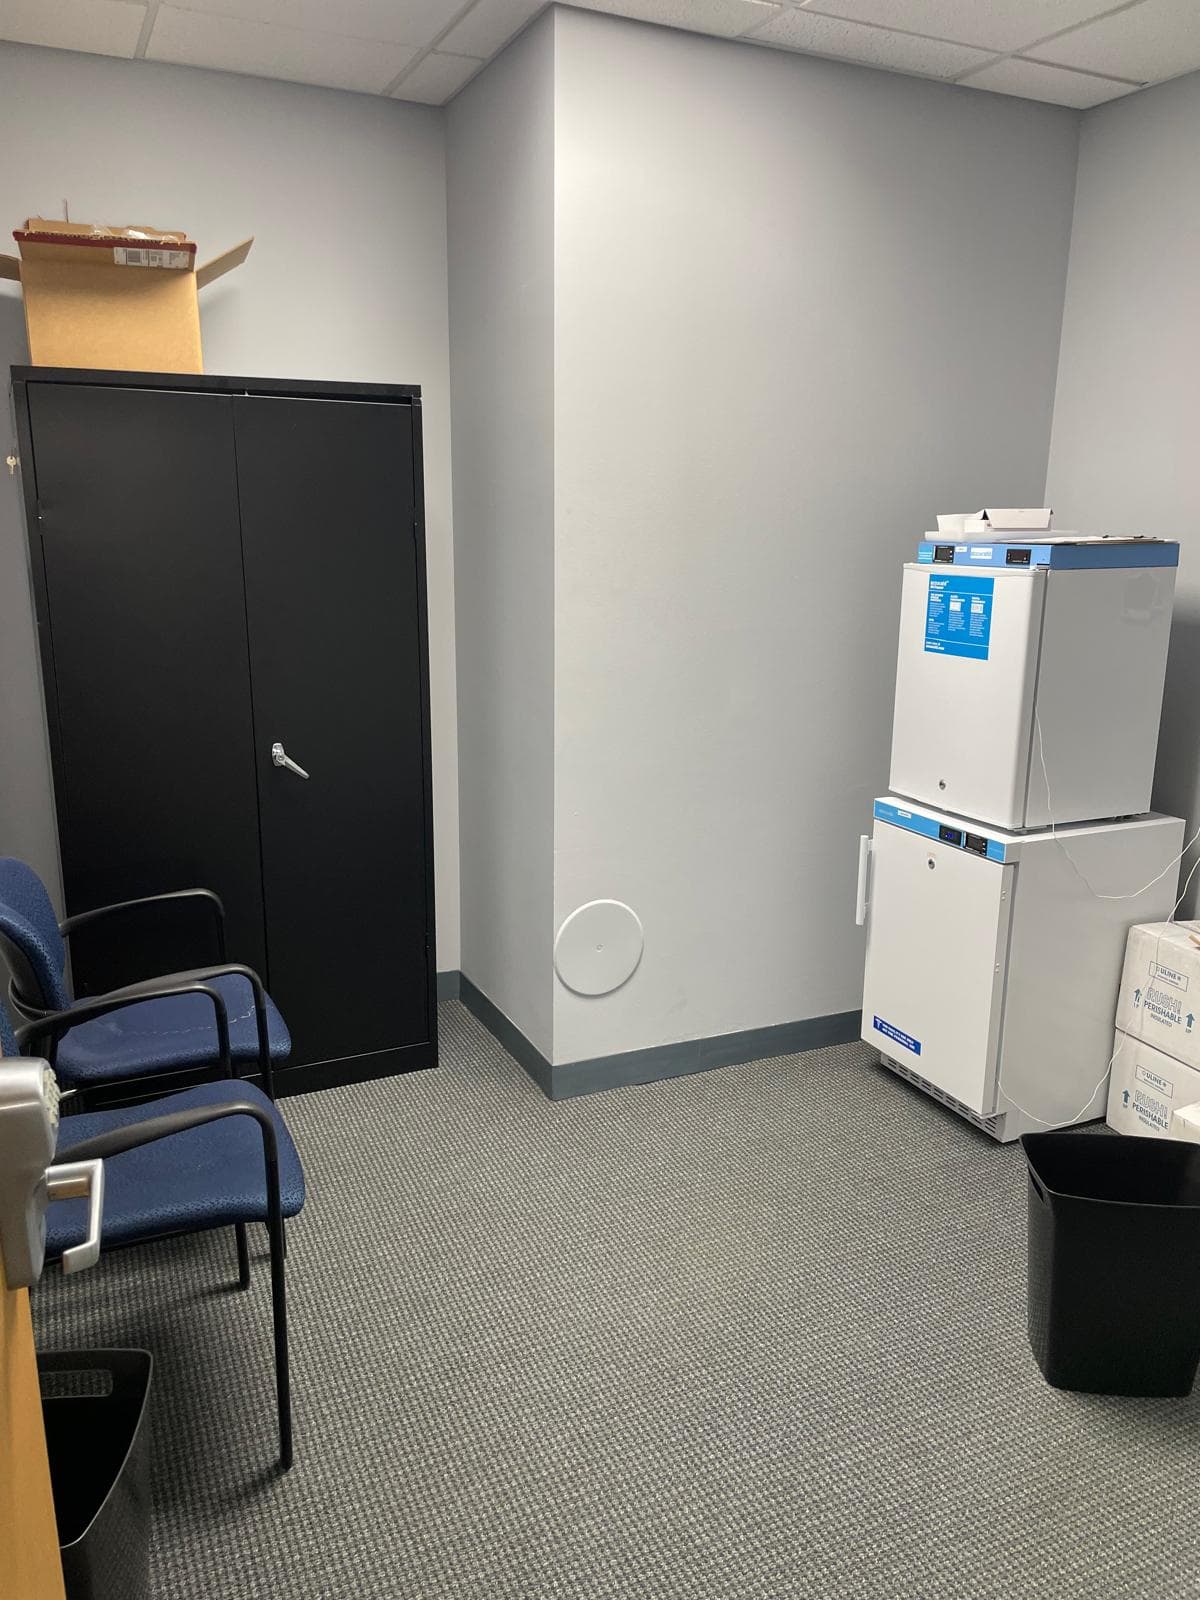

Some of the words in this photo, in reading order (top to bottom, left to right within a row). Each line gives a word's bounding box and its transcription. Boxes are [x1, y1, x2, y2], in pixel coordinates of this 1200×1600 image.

[1160, 967, 1177, 981] ULINE
[1143, 1000, 1182, 1025] PERISHABLE
[1146, 1072, 1163, 1086] ULINE
[1132, 1102, 1169, 1130] PERISHABLE
